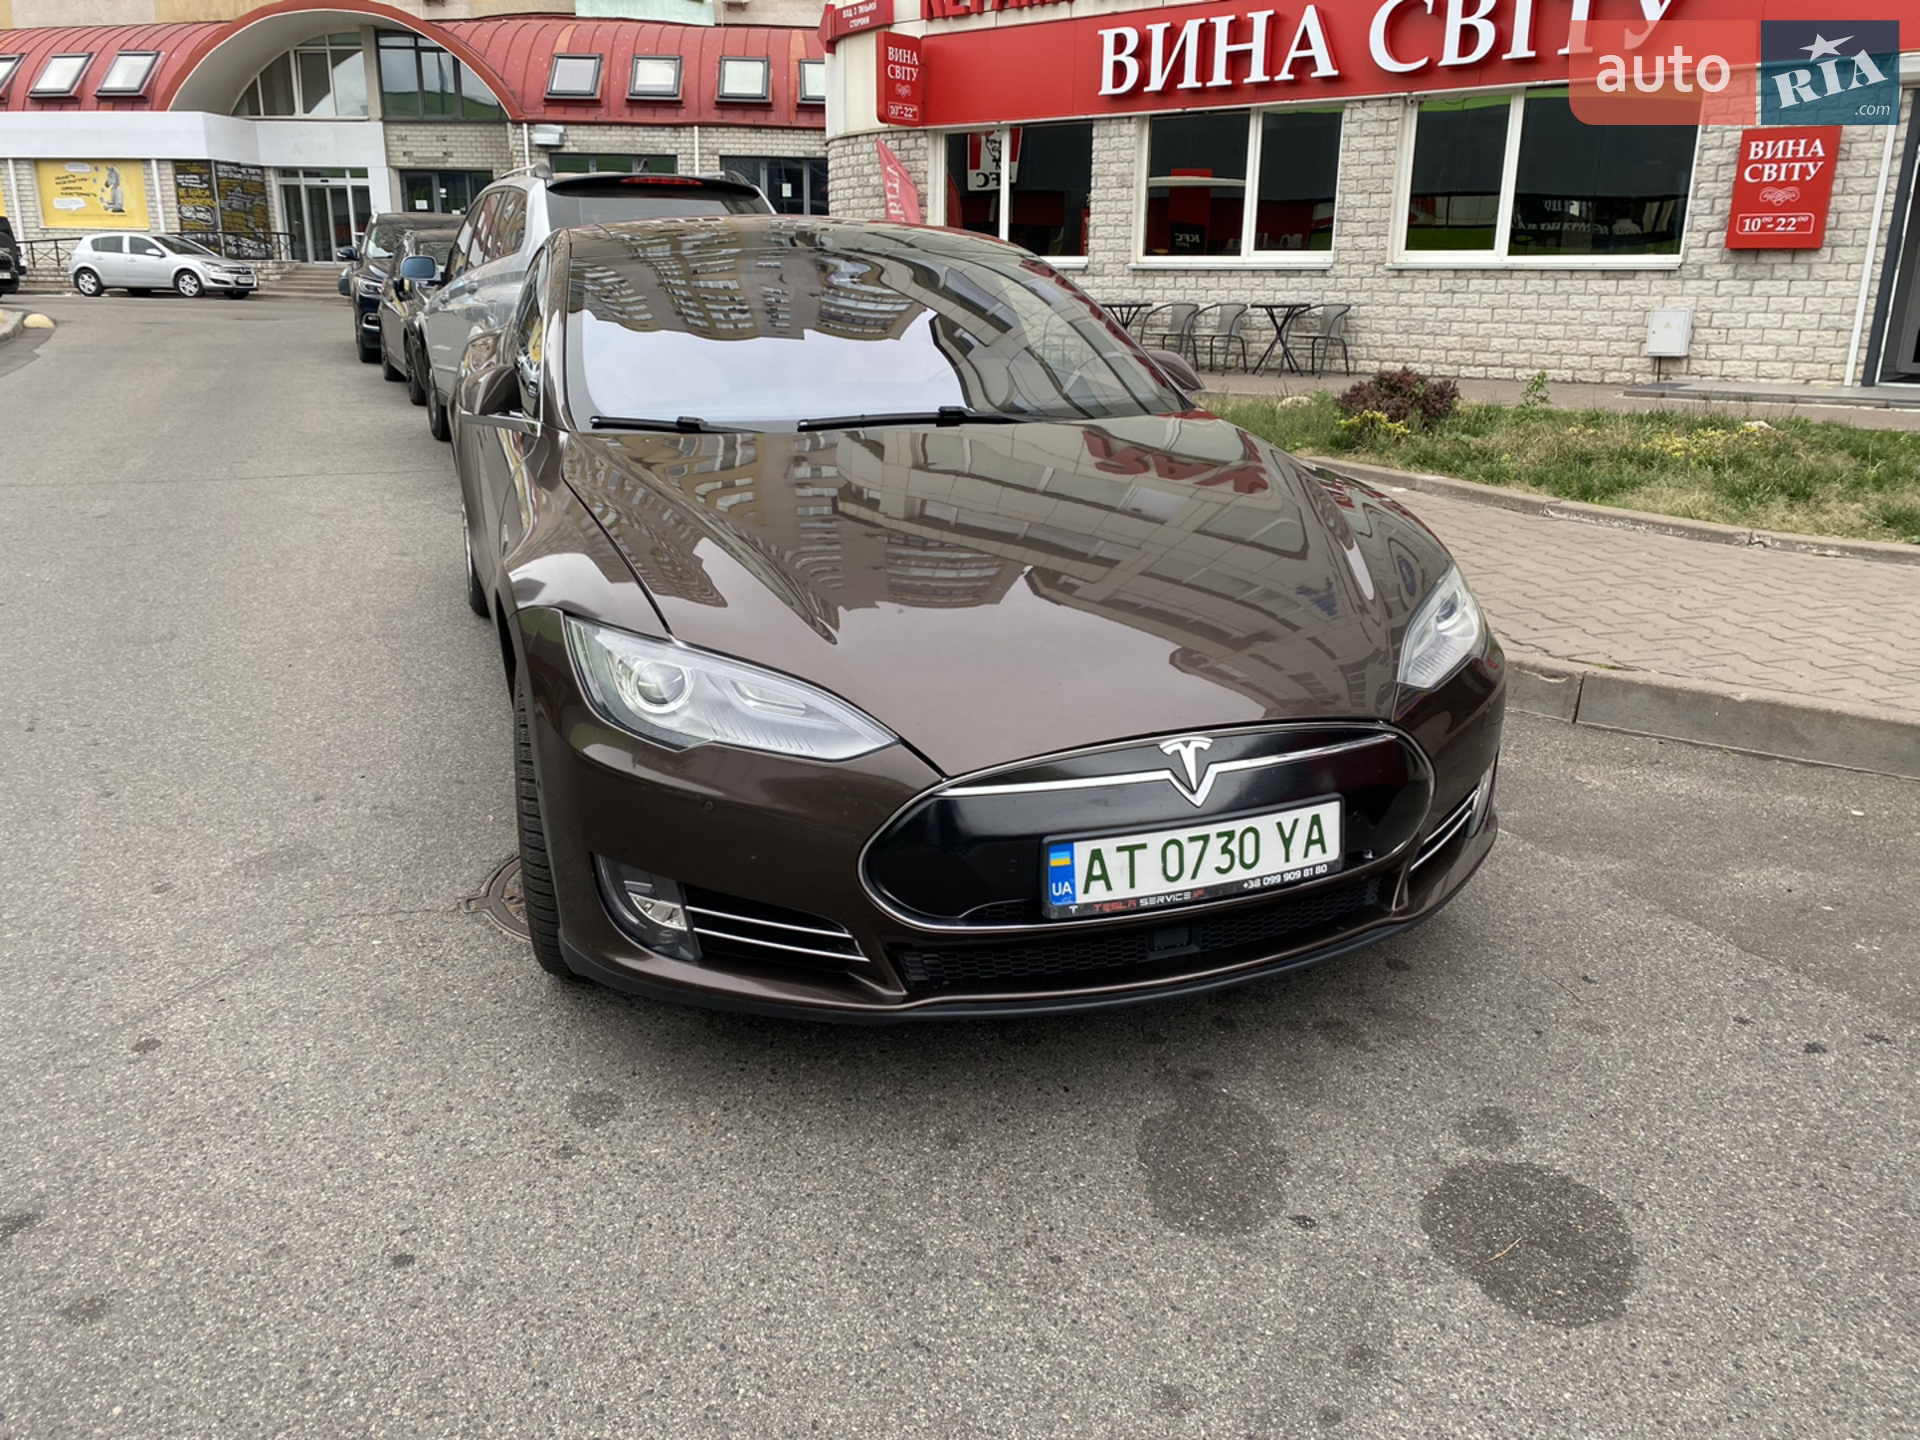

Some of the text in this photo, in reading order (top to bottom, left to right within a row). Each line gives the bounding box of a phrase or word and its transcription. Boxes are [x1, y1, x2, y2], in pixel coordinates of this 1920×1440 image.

[887, 46, 919, 65] ВИНА
[1098, 4, 1339, 96] ВИНА
[887, 64, 919, 82] СВІТУ
[1748, 138, 1826, 161] ВИНА
[1743, 161, 1825, 183] СВІТУ
[1083, 813, 1328, 894] AT 0730 YA
[1243, 863, 1328, 889] +38 099 909 81 80
[1052, 881, 1073, 896] UA
[1094, 899, 1137, 913] TESLA
[1139, 891, 1192, 906] SERVICE
